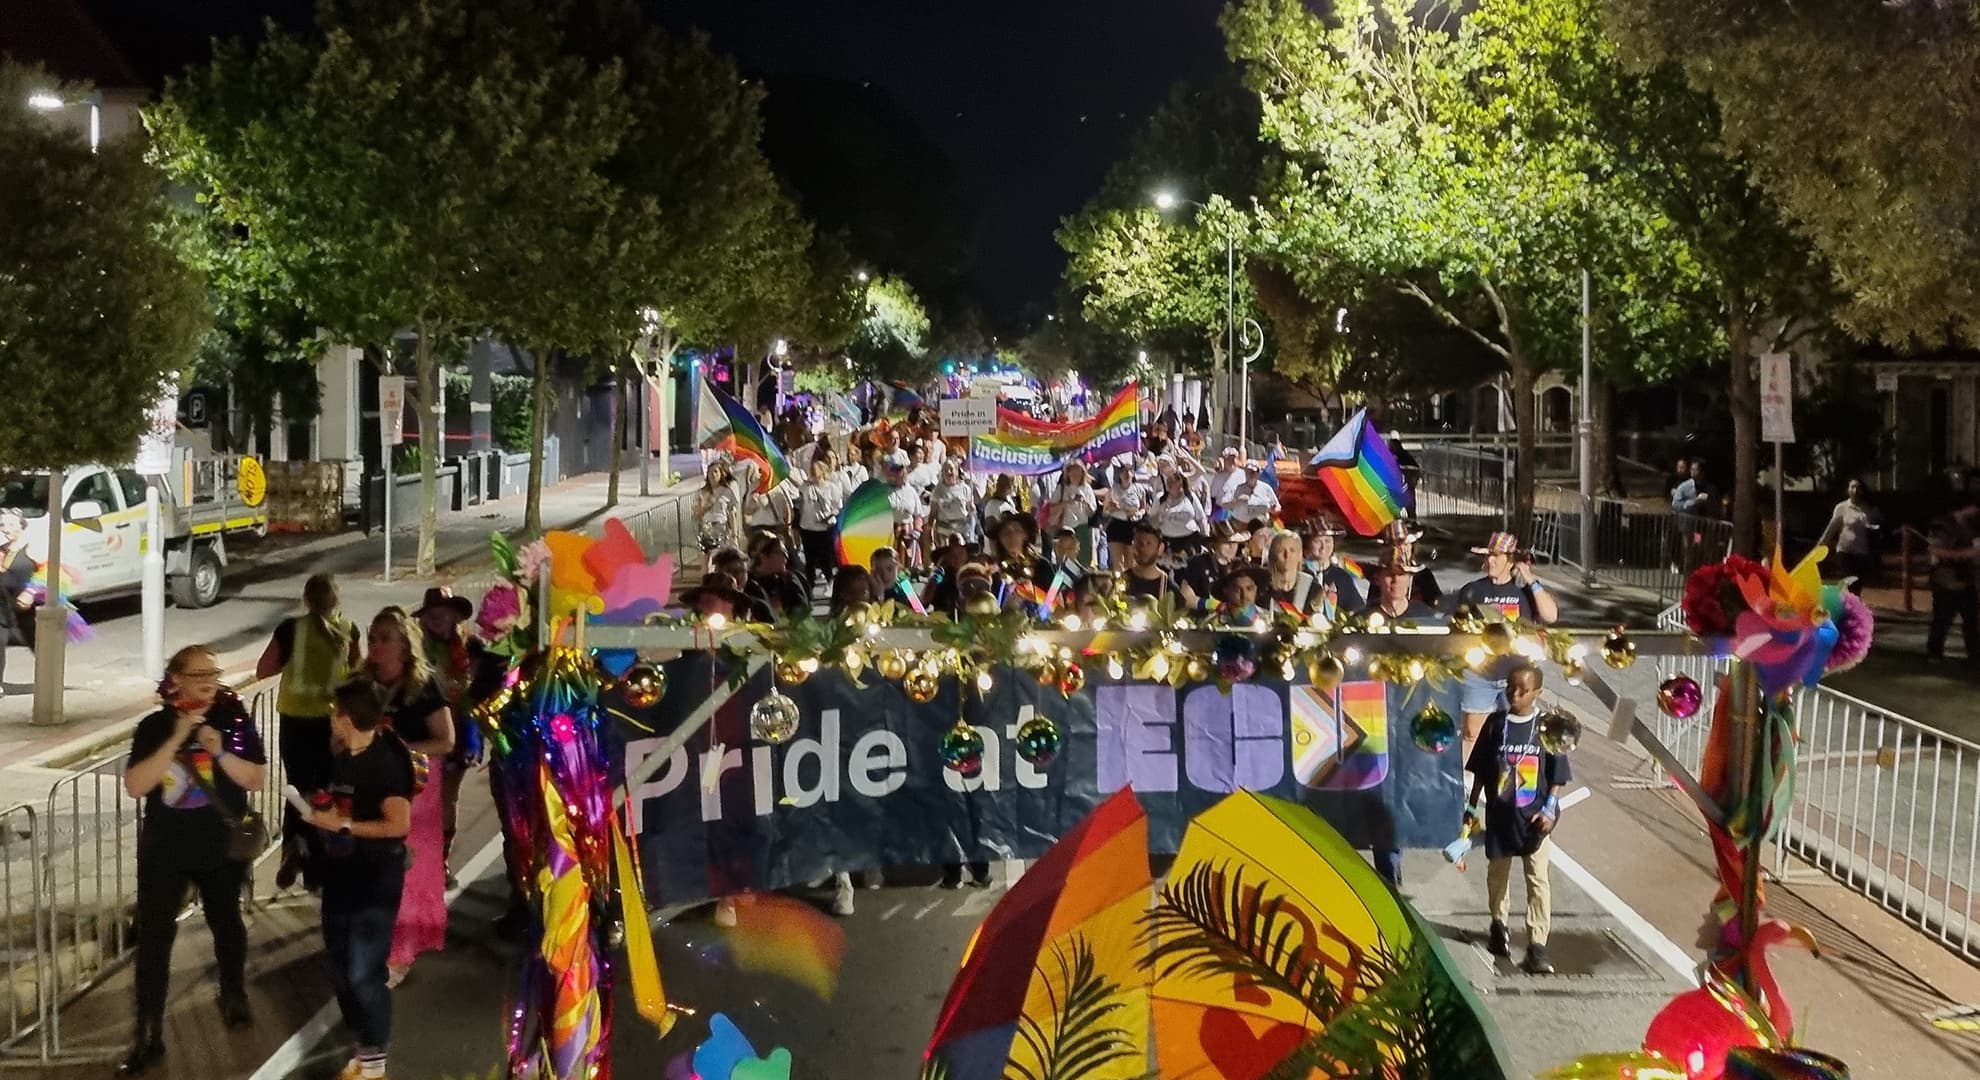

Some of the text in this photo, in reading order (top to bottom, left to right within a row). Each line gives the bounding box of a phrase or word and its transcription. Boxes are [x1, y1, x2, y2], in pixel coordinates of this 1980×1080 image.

[944, 418, 993, 427] Resources
[951, 409, 986, 418] Pride in
[975, 439, 1053, 465] inclusive
[244, 463, 257, 503] SLOW
[624, 680, 1389, 837] Pride at ECU
